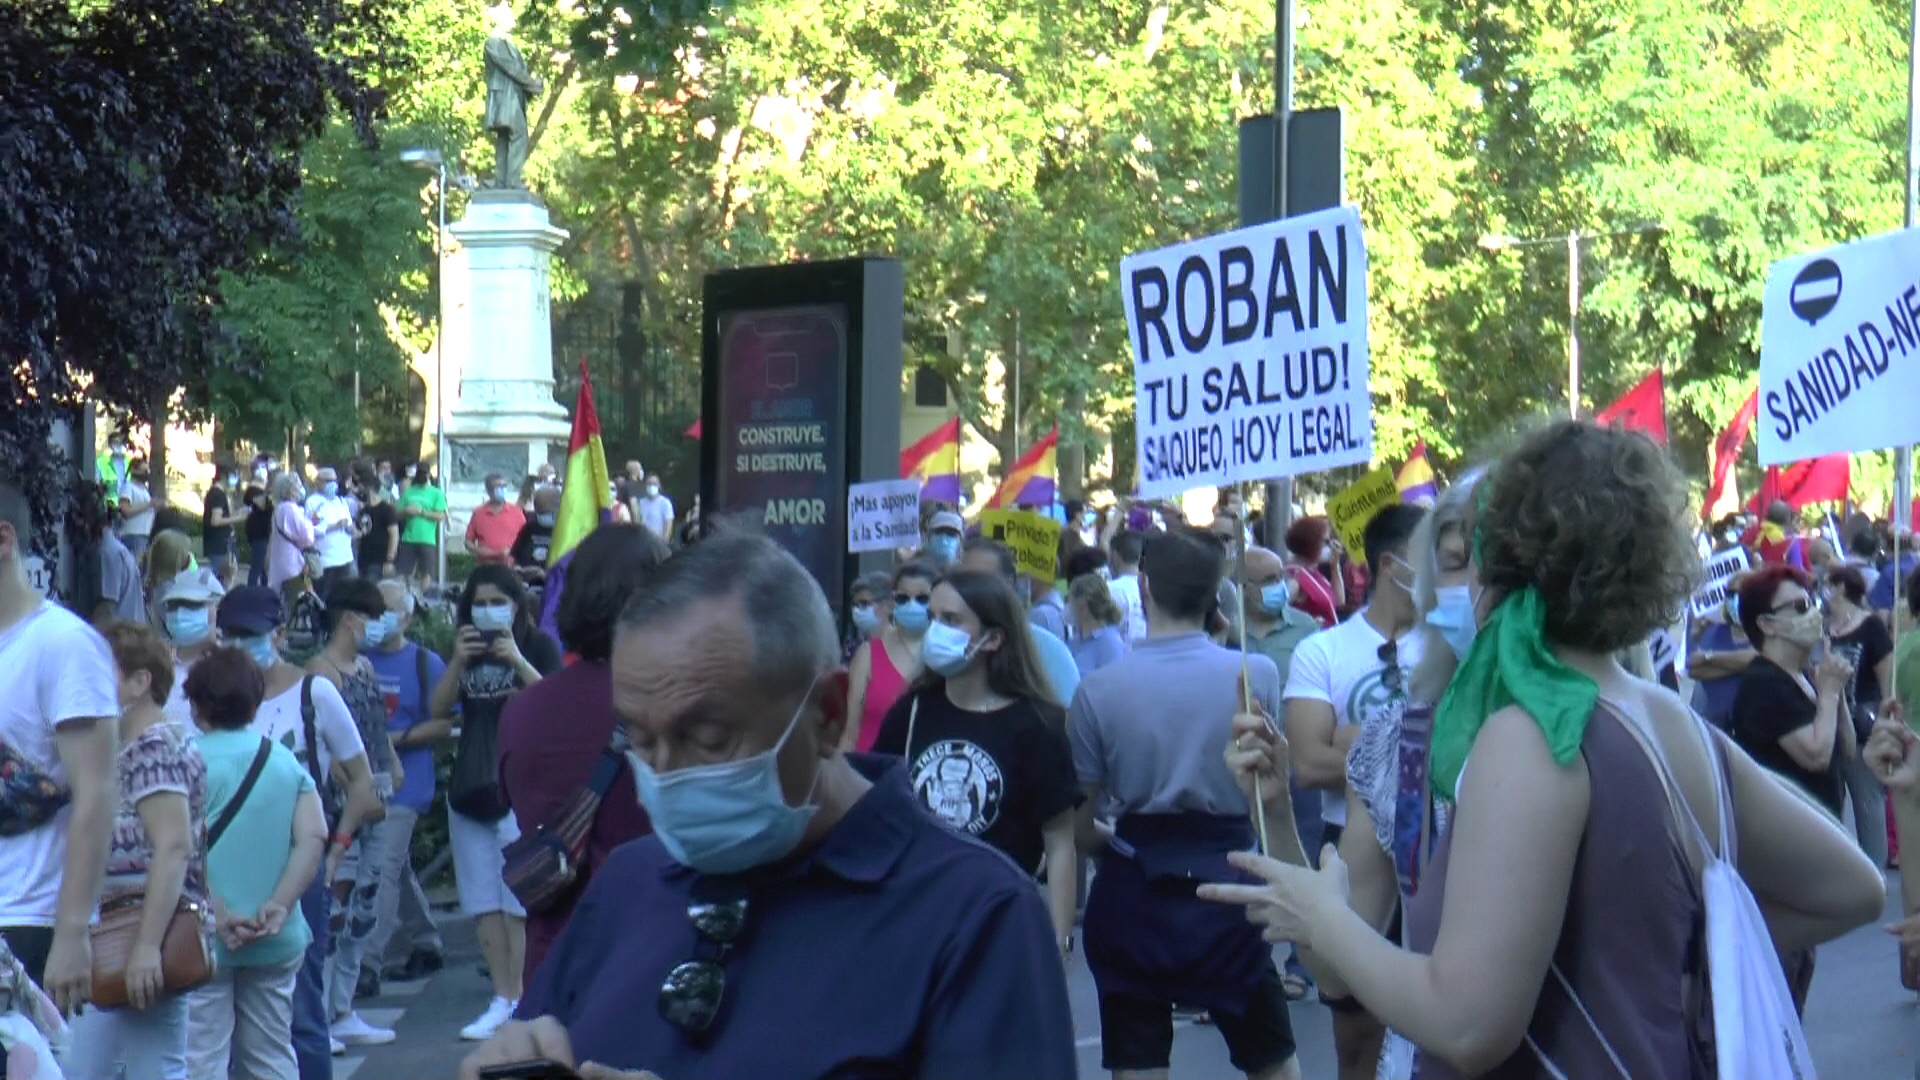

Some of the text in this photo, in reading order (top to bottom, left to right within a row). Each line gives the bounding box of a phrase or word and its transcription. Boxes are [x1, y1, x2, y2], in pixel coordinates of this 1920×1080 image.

[1131, 224, 1348, 364] ROBAN
[1144, 342, 1350, 426] TU SALUD!
[1765, 277, 1920, 442] SANIDAD-NE
[735, 452, 827, 474] SI DESTRUYE,
[738, 425, 825, 446] CONSTRUYE.
[1144, 403, 1364, 482] SAQUEO, HOY LEGAL.
[763, 499, 826, 525] AMOR
